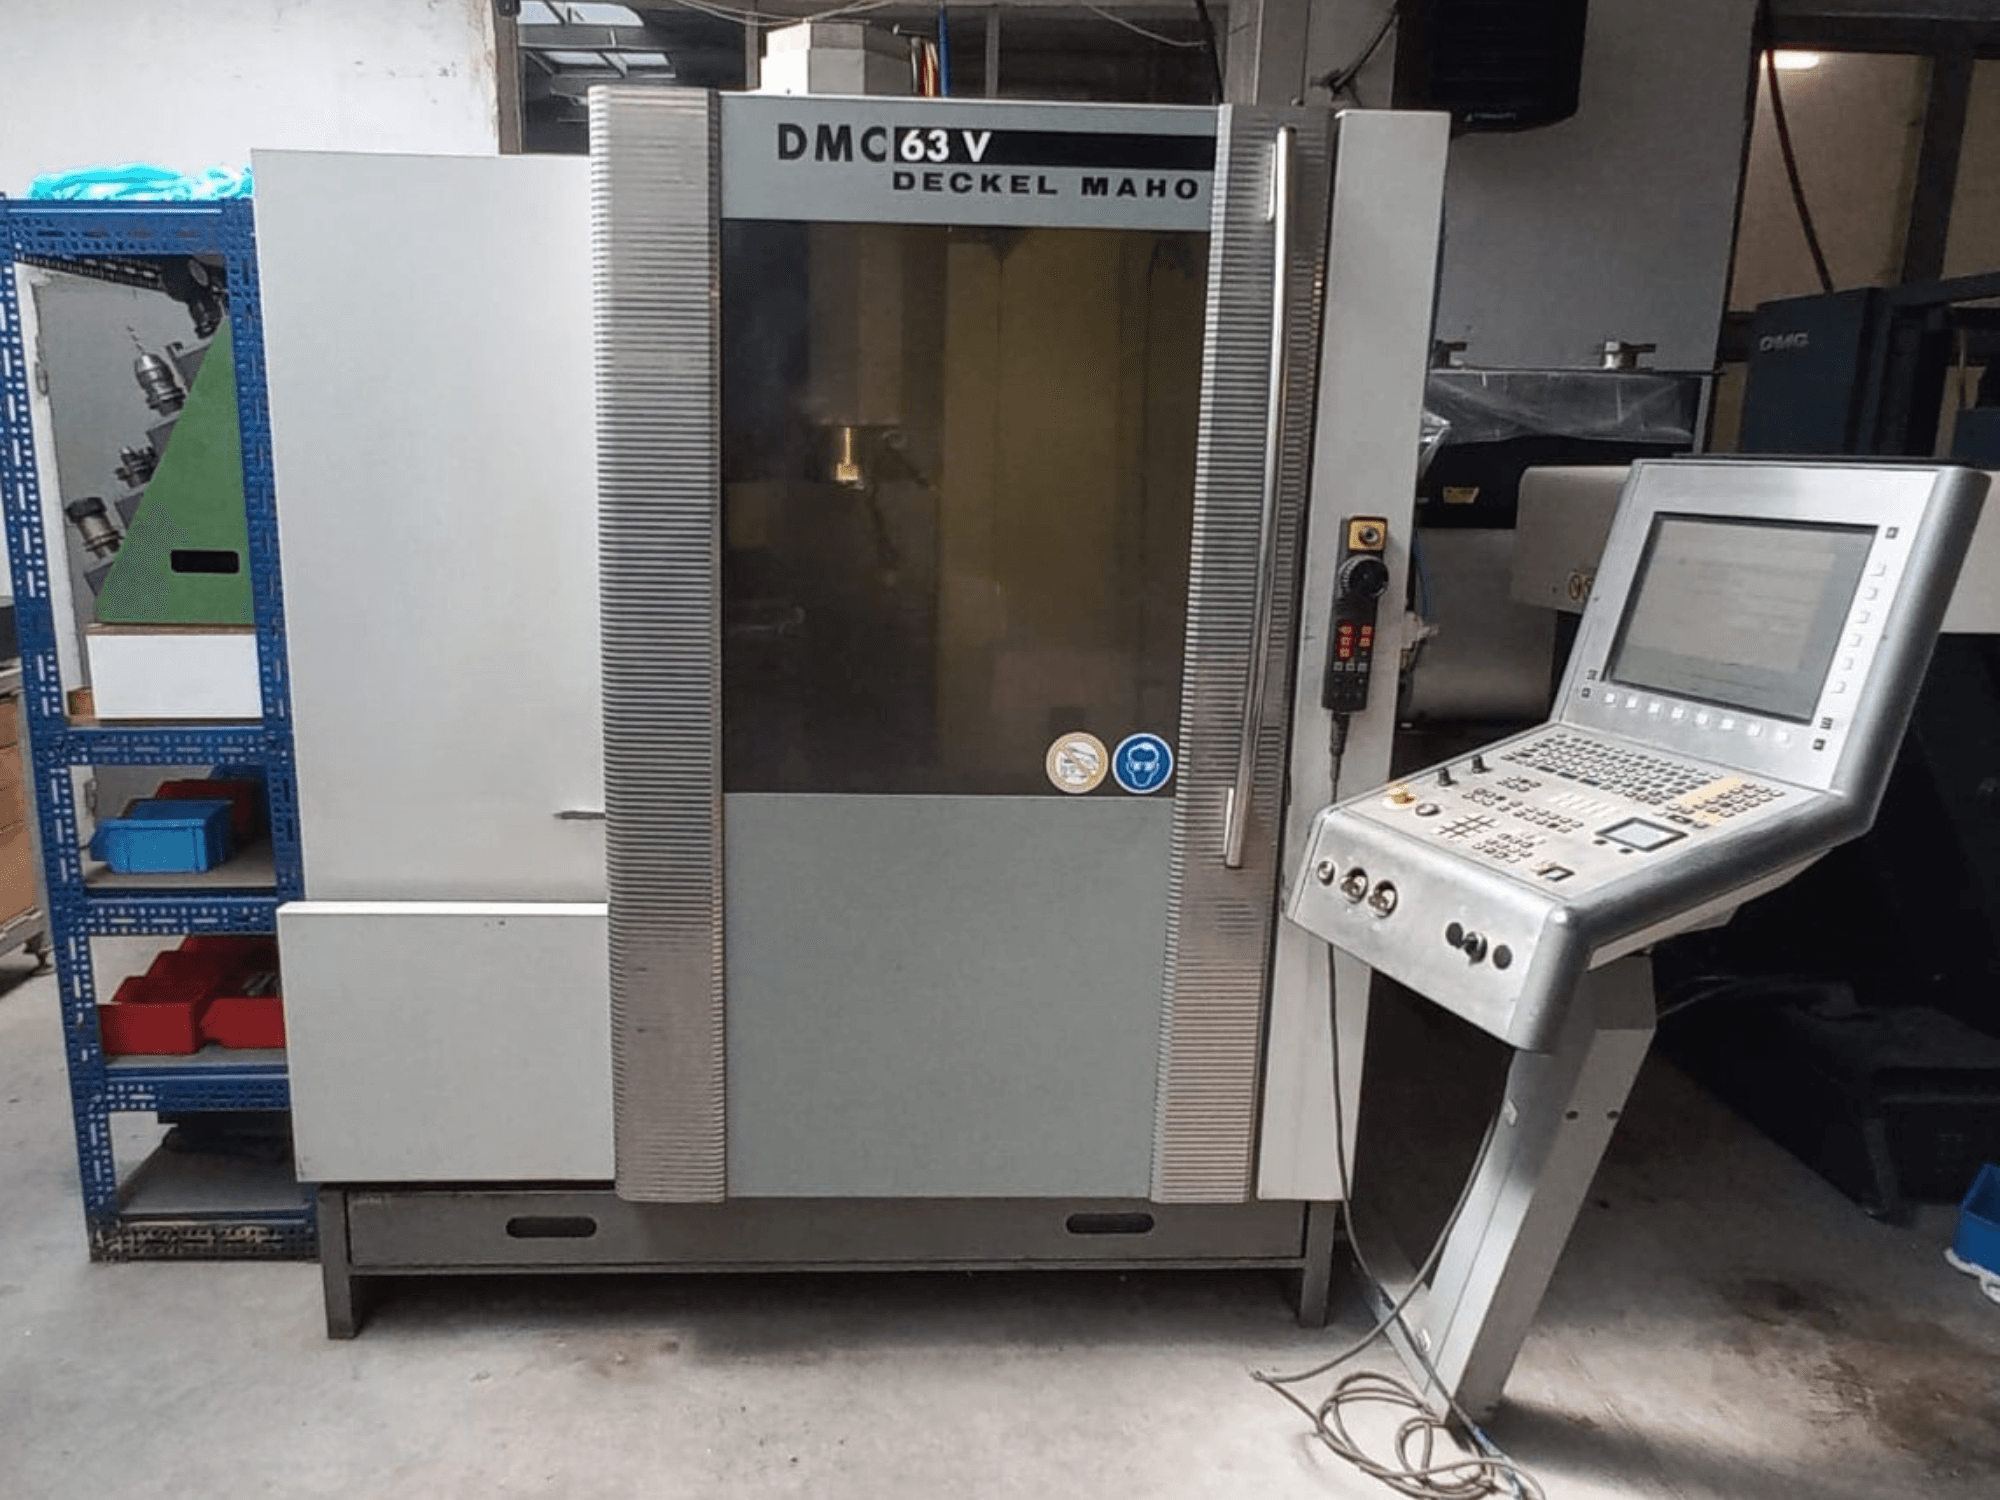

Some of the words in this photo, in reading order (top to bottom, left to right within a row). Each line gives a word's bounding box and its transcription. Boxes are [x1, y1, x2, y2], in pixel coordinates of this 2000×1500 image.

[777, 123, 887, 163] DMC
[900, 129, 950, 162] 63
[962, 130, 993, 162] V
[893, 171, 1058, 195] DECKEL
[1081, 176, 1199, 200] MAHO
